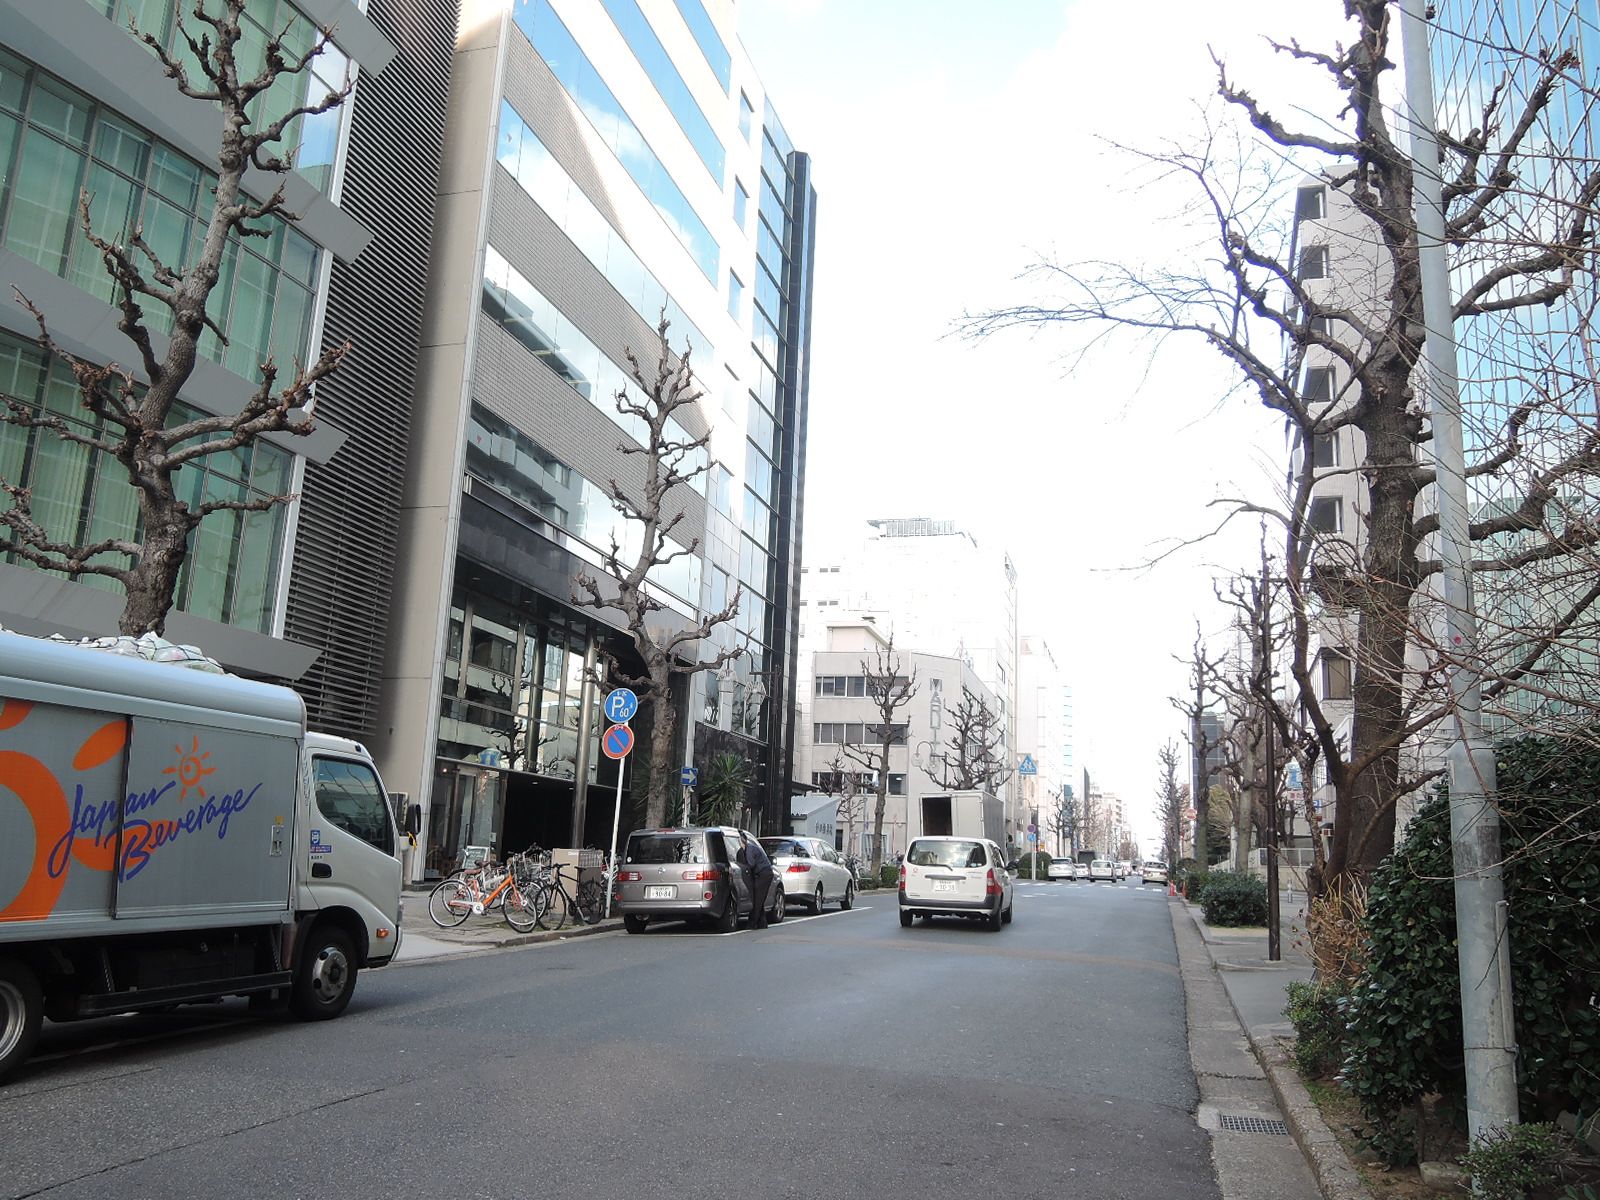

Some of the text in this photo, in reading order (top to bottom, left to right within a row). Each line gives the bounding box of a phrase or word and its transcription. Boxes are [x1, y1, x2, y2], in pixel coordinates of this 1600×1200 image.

[611, 696, 625, 717] P
[619, 707, 629, 718] 60
[48, 780, 176, 878] Japan
[104, 783, 263, 883] Beverage
